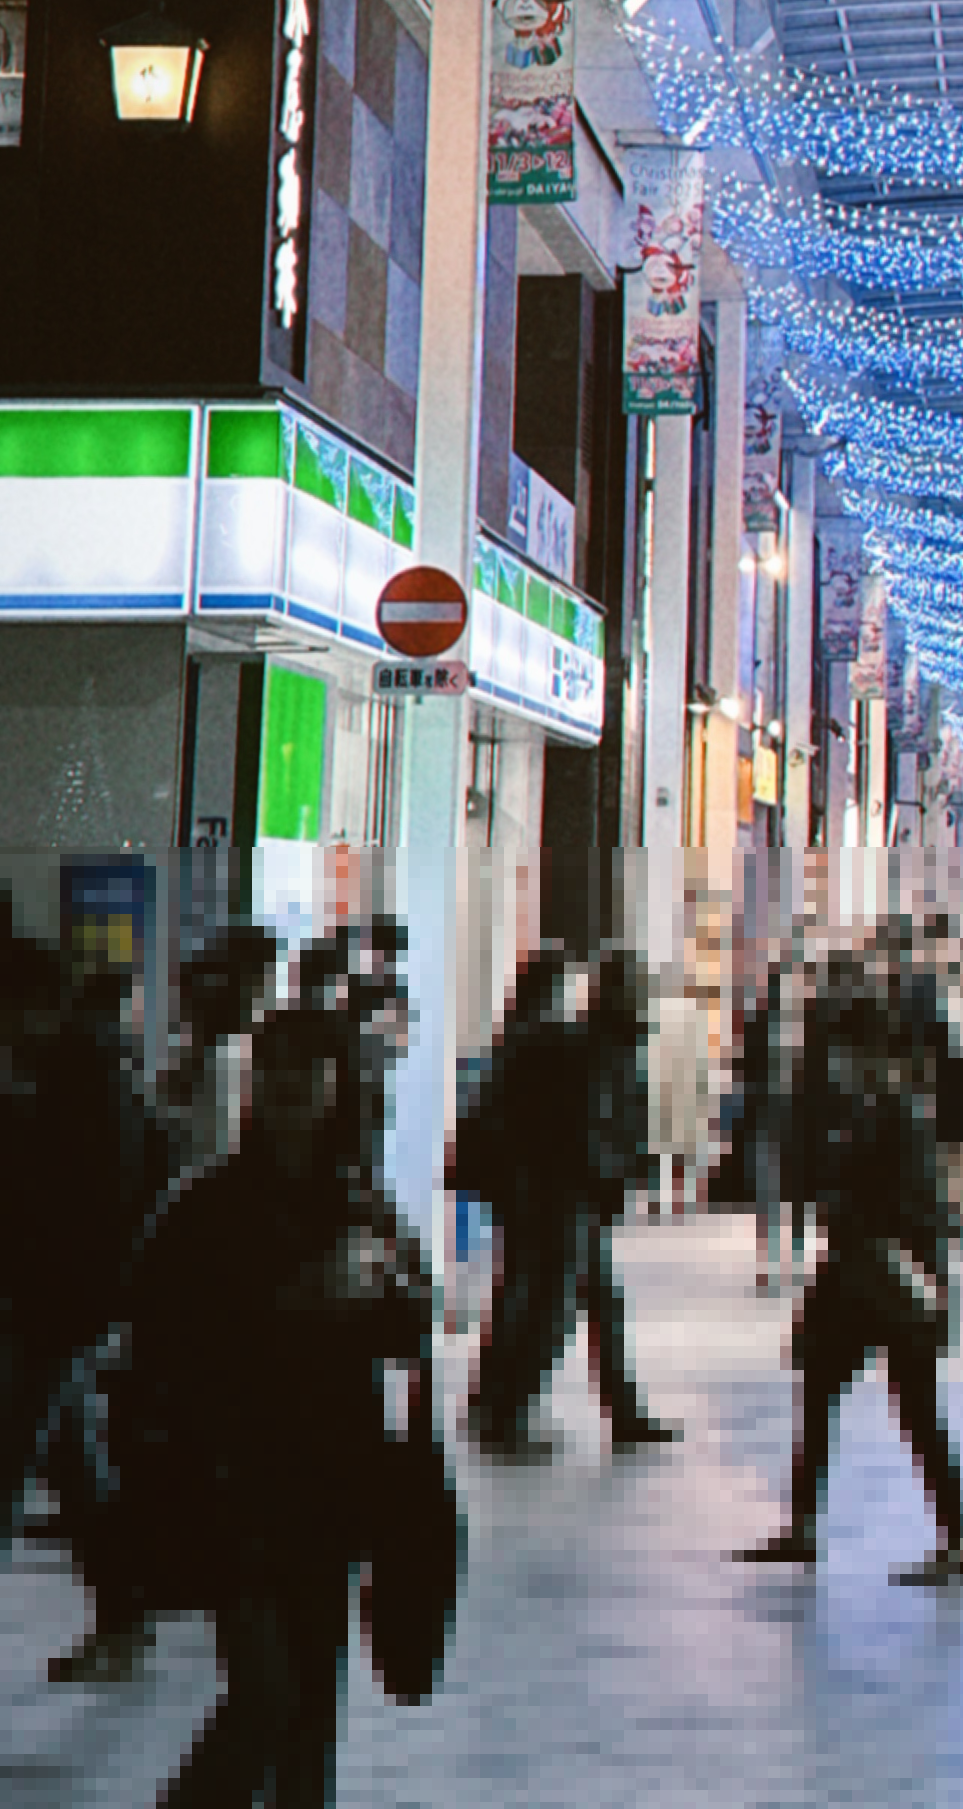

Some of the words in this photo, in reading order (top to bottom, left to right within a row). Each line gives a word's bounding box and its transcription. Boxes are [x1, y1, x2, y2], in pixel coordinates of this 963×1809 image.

[378, 667, 459, 689] 自転車を除く
